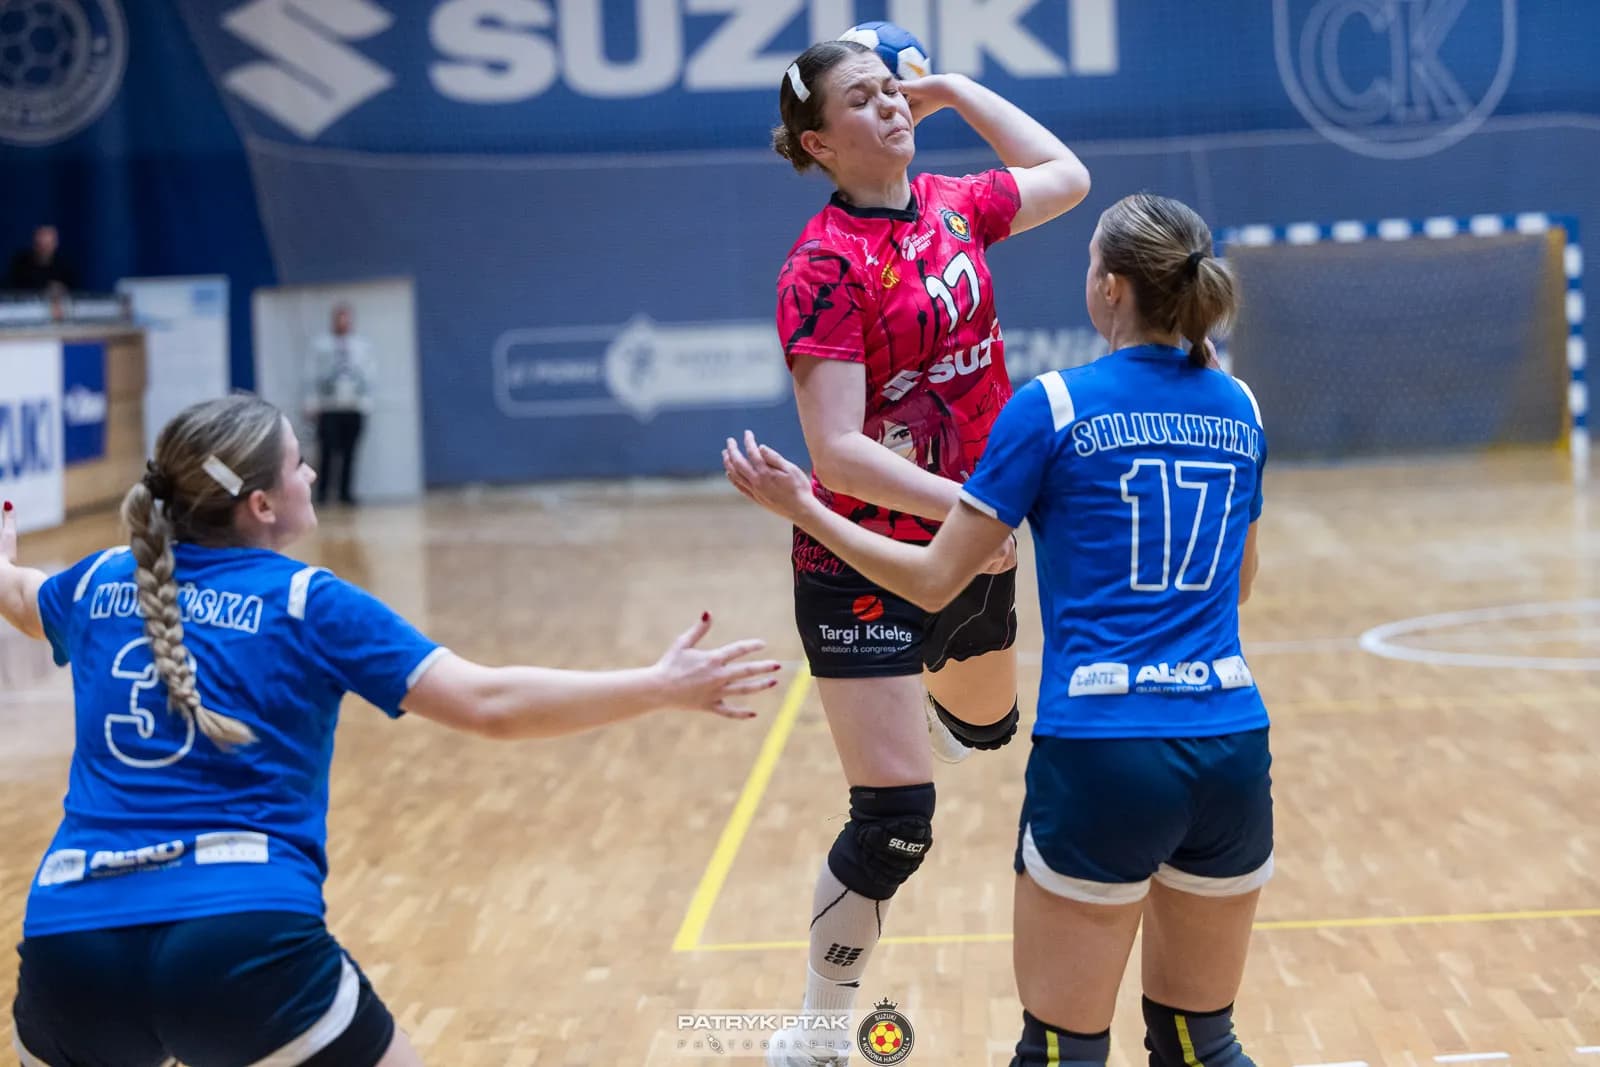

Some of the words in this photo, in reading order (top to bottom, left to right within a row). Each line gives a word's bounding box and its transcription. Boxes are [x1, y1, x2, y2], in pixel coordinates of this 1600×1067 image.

[926, 252, 980, 336] 17
[928, 330, 1002, 384] SUZ
[1120, 459, 1236, 591] 17
[90, 582, 263, 634] NOŃSKA
[819, 625, 860, 644] Targi
[866, 625, 912, 642] Kielce
[105, 637, 198, 768] 3
[888, 838, 925, 853] SELECT
